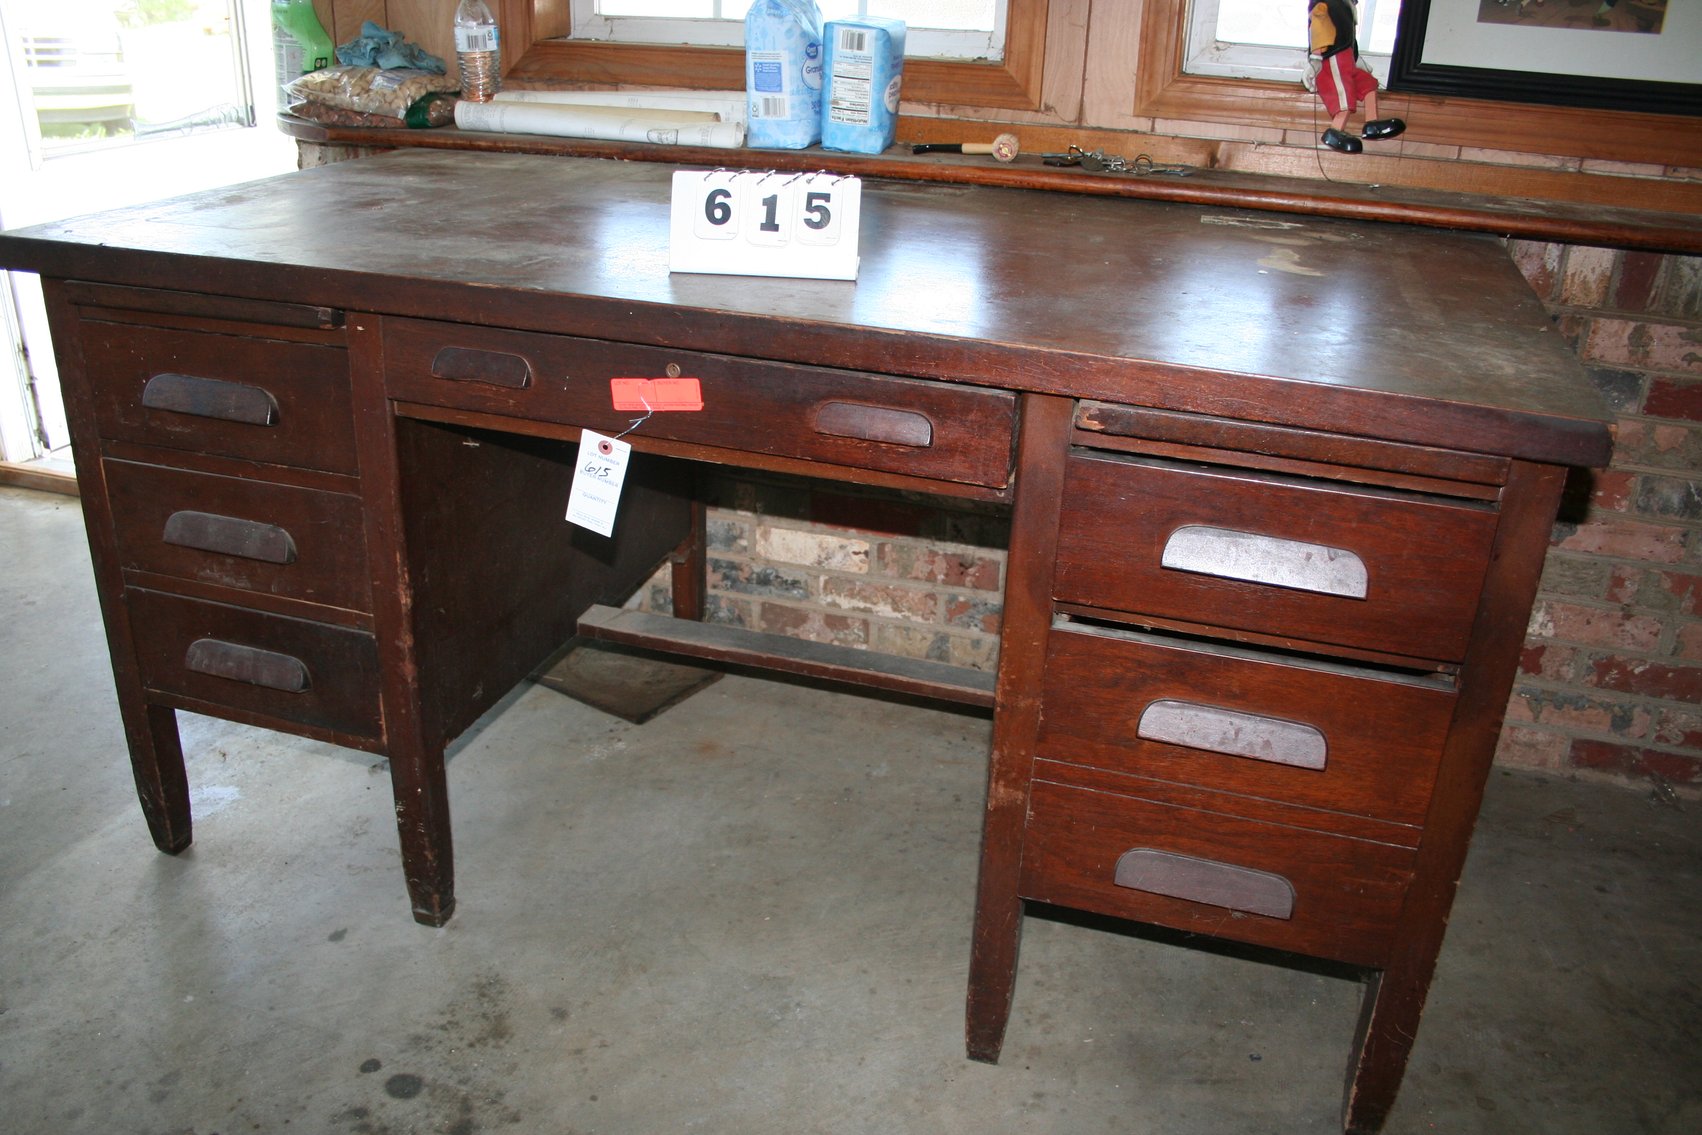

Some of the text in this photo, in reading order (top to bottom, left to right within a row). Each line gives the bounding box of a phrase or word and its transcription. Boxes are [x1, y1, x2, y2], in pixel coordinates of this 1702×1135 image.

[598, 455, 620, 466] NUMBER
[584, 461, 612, 477] 615
[597, 476, 619, 488] NUMBER
[582, 491, 607, 505] QUANTITY
